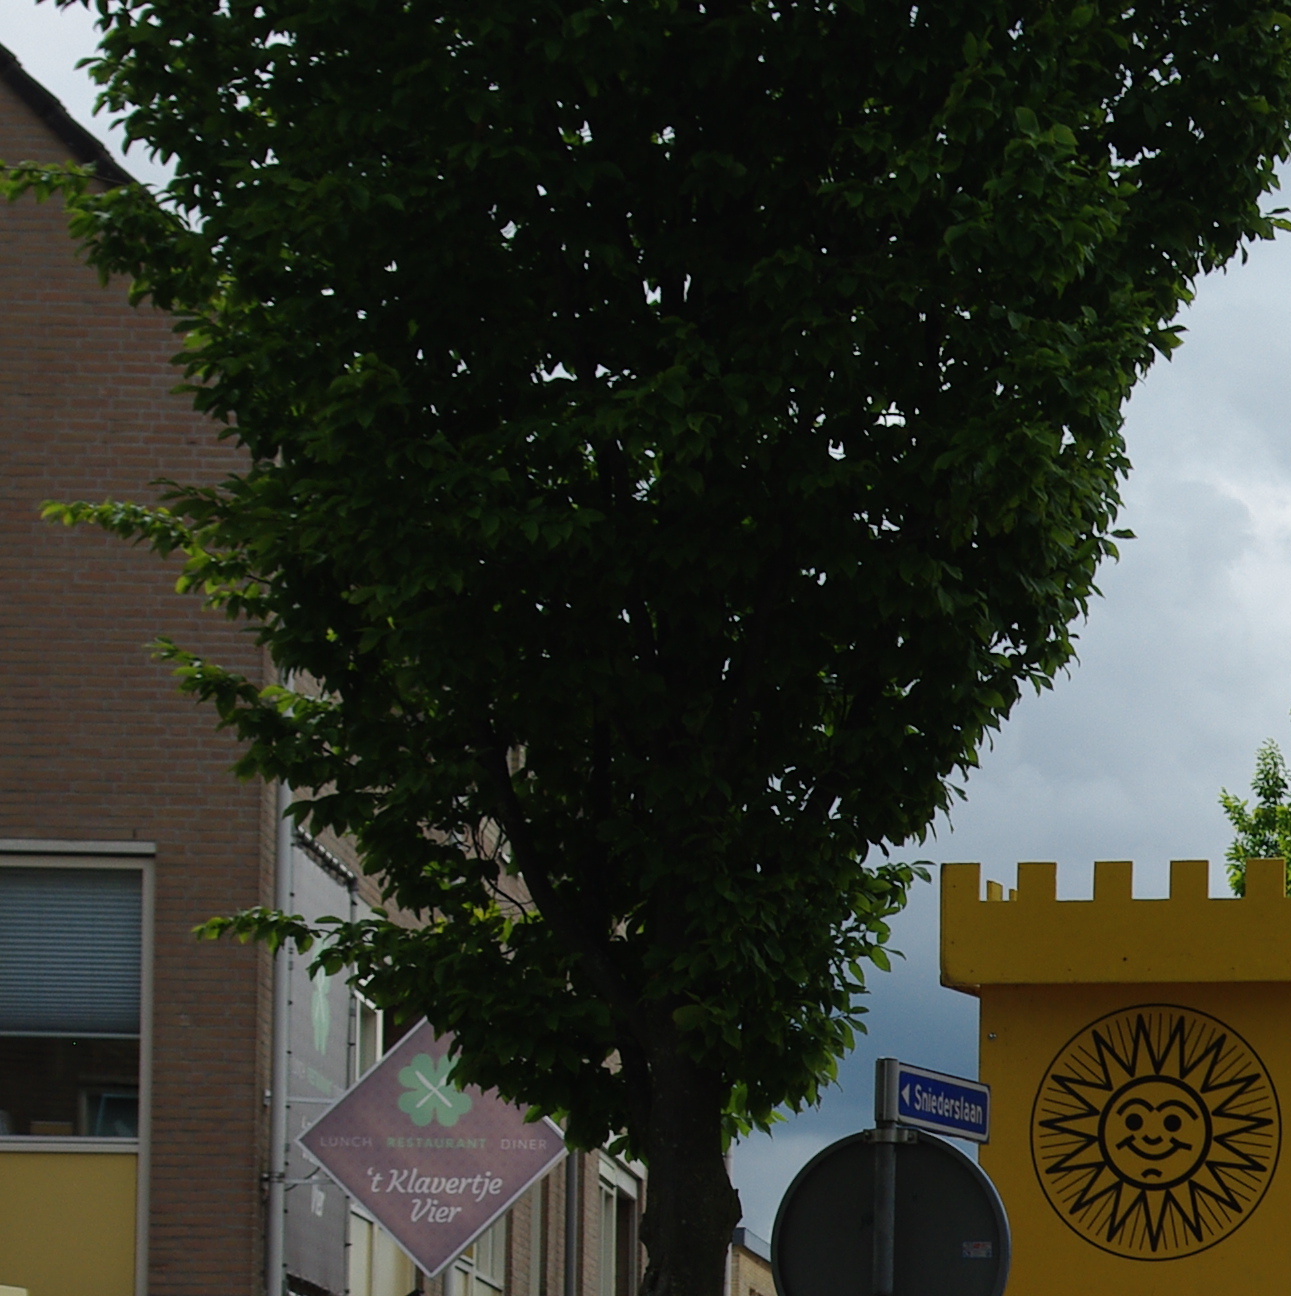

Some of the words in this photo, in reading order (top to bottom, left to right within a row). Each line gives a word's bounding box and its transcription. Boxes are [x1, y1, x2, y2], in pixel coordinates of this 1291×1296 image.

[913, 1084, 983, 1125] Sniederslaan
[319, 1136, 373, 1148] LUNCH
[386, 1137, 487, 1149] RESTAURANT
[500, 1139, 547, 1150] DINER
[385, 1167, 504, 1202] Klavertje
[410, 1198, 462, 1223] Vier
